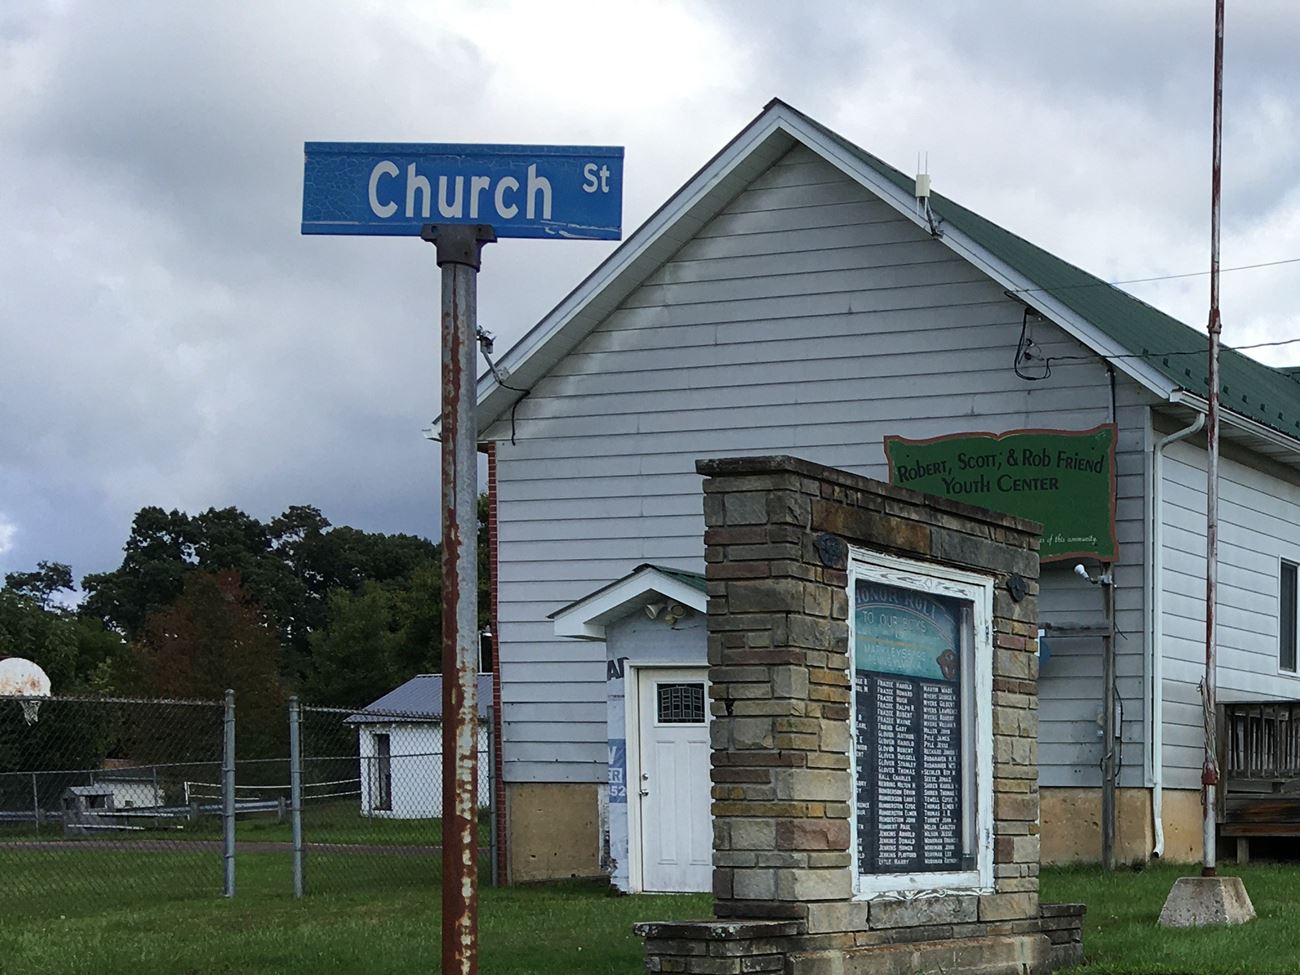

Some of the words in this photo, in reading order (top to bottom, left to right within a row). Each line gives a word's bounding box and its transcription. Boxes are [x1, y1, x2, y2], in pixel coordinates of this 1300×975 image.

[368, 160, 552, 220] Church
[582, 163, 610, 193] St
[1007, 448, 1018, 467] &
[862, 610, 874, 624] TO
[880, 614, 898, 628] OUR
